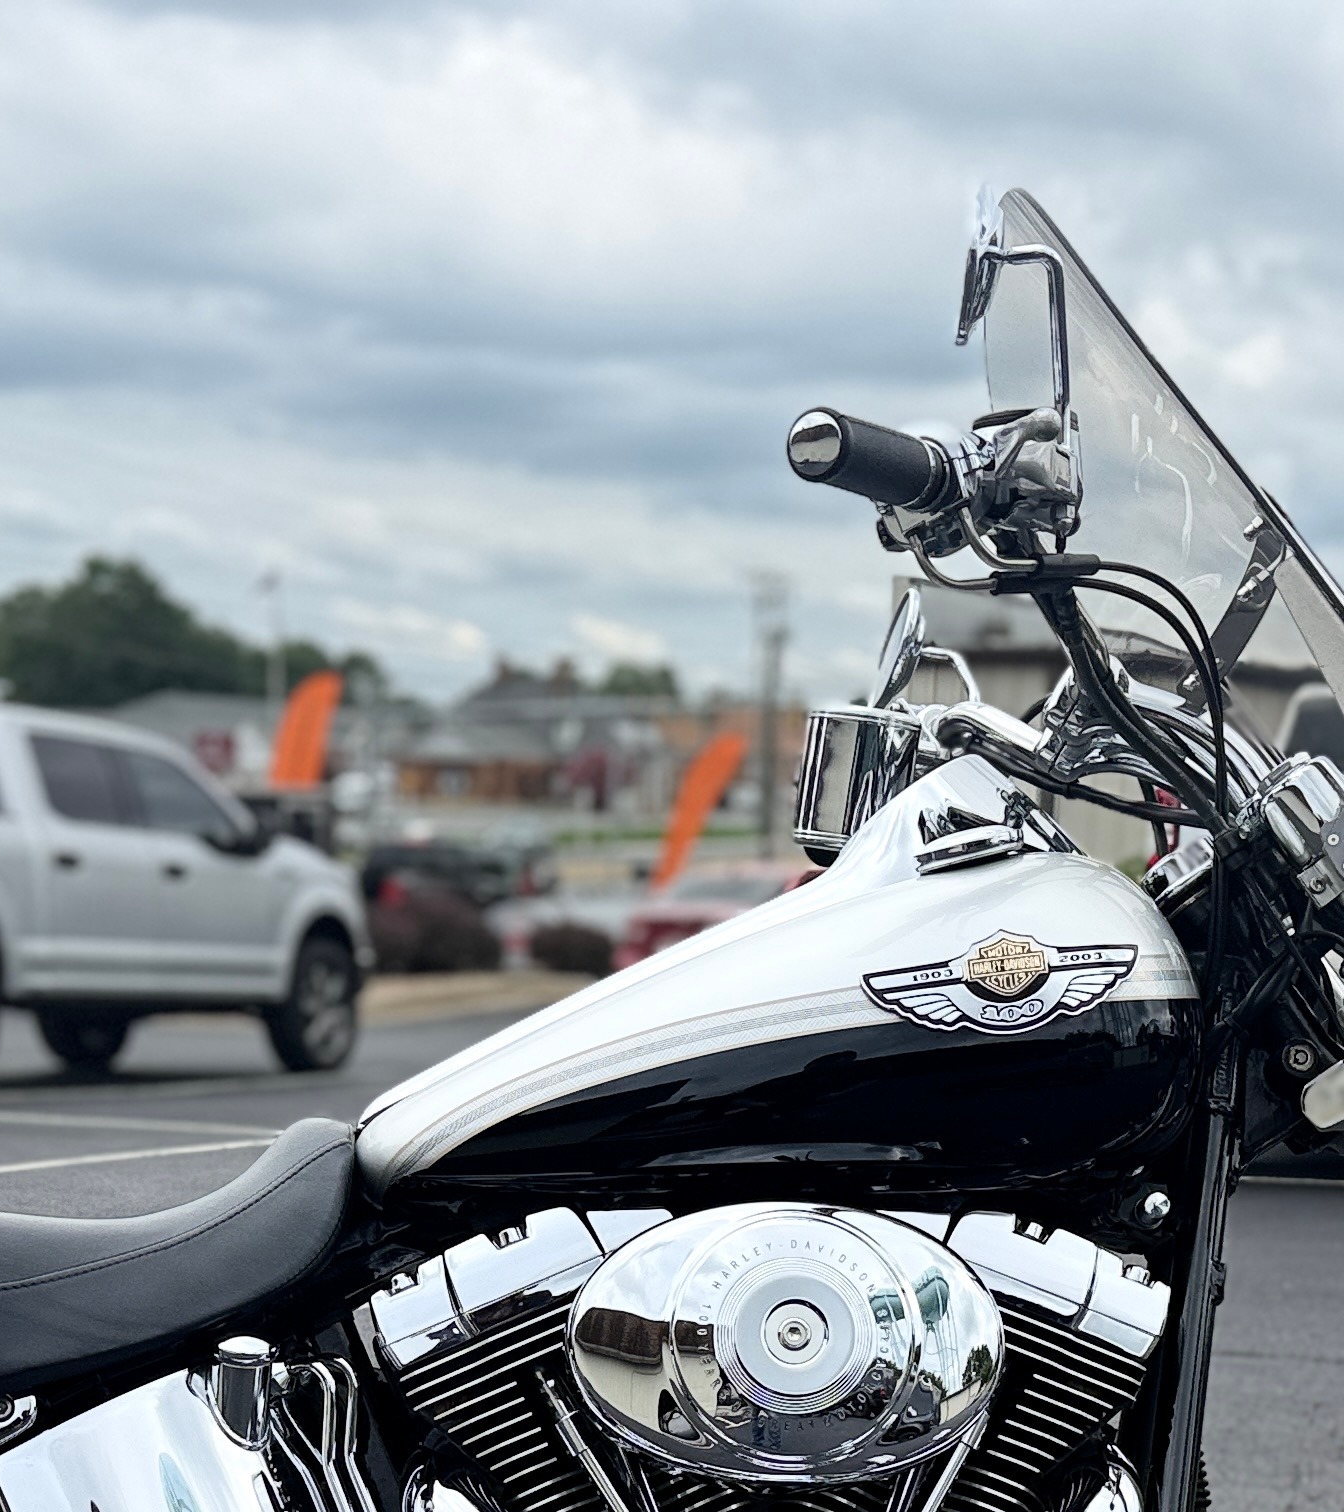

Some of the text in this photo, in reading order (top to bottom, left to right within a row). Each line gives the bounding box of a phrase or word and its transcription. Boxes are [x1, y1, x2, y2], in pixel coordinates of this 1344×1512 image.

[980, 940, 1030, 958] MOTOR
[1058, 952, 1103, 963] 2003
[973, 954, 1042, 975] HARLEY-DAVIDSON
[912, 968, 954, 982] 1903
[987, 970, 1037, 989] CYCLES
[980, 999, 1044, 1021] 100
[712, 1239, 876, 1293] HARLEY-DAVIDSON
